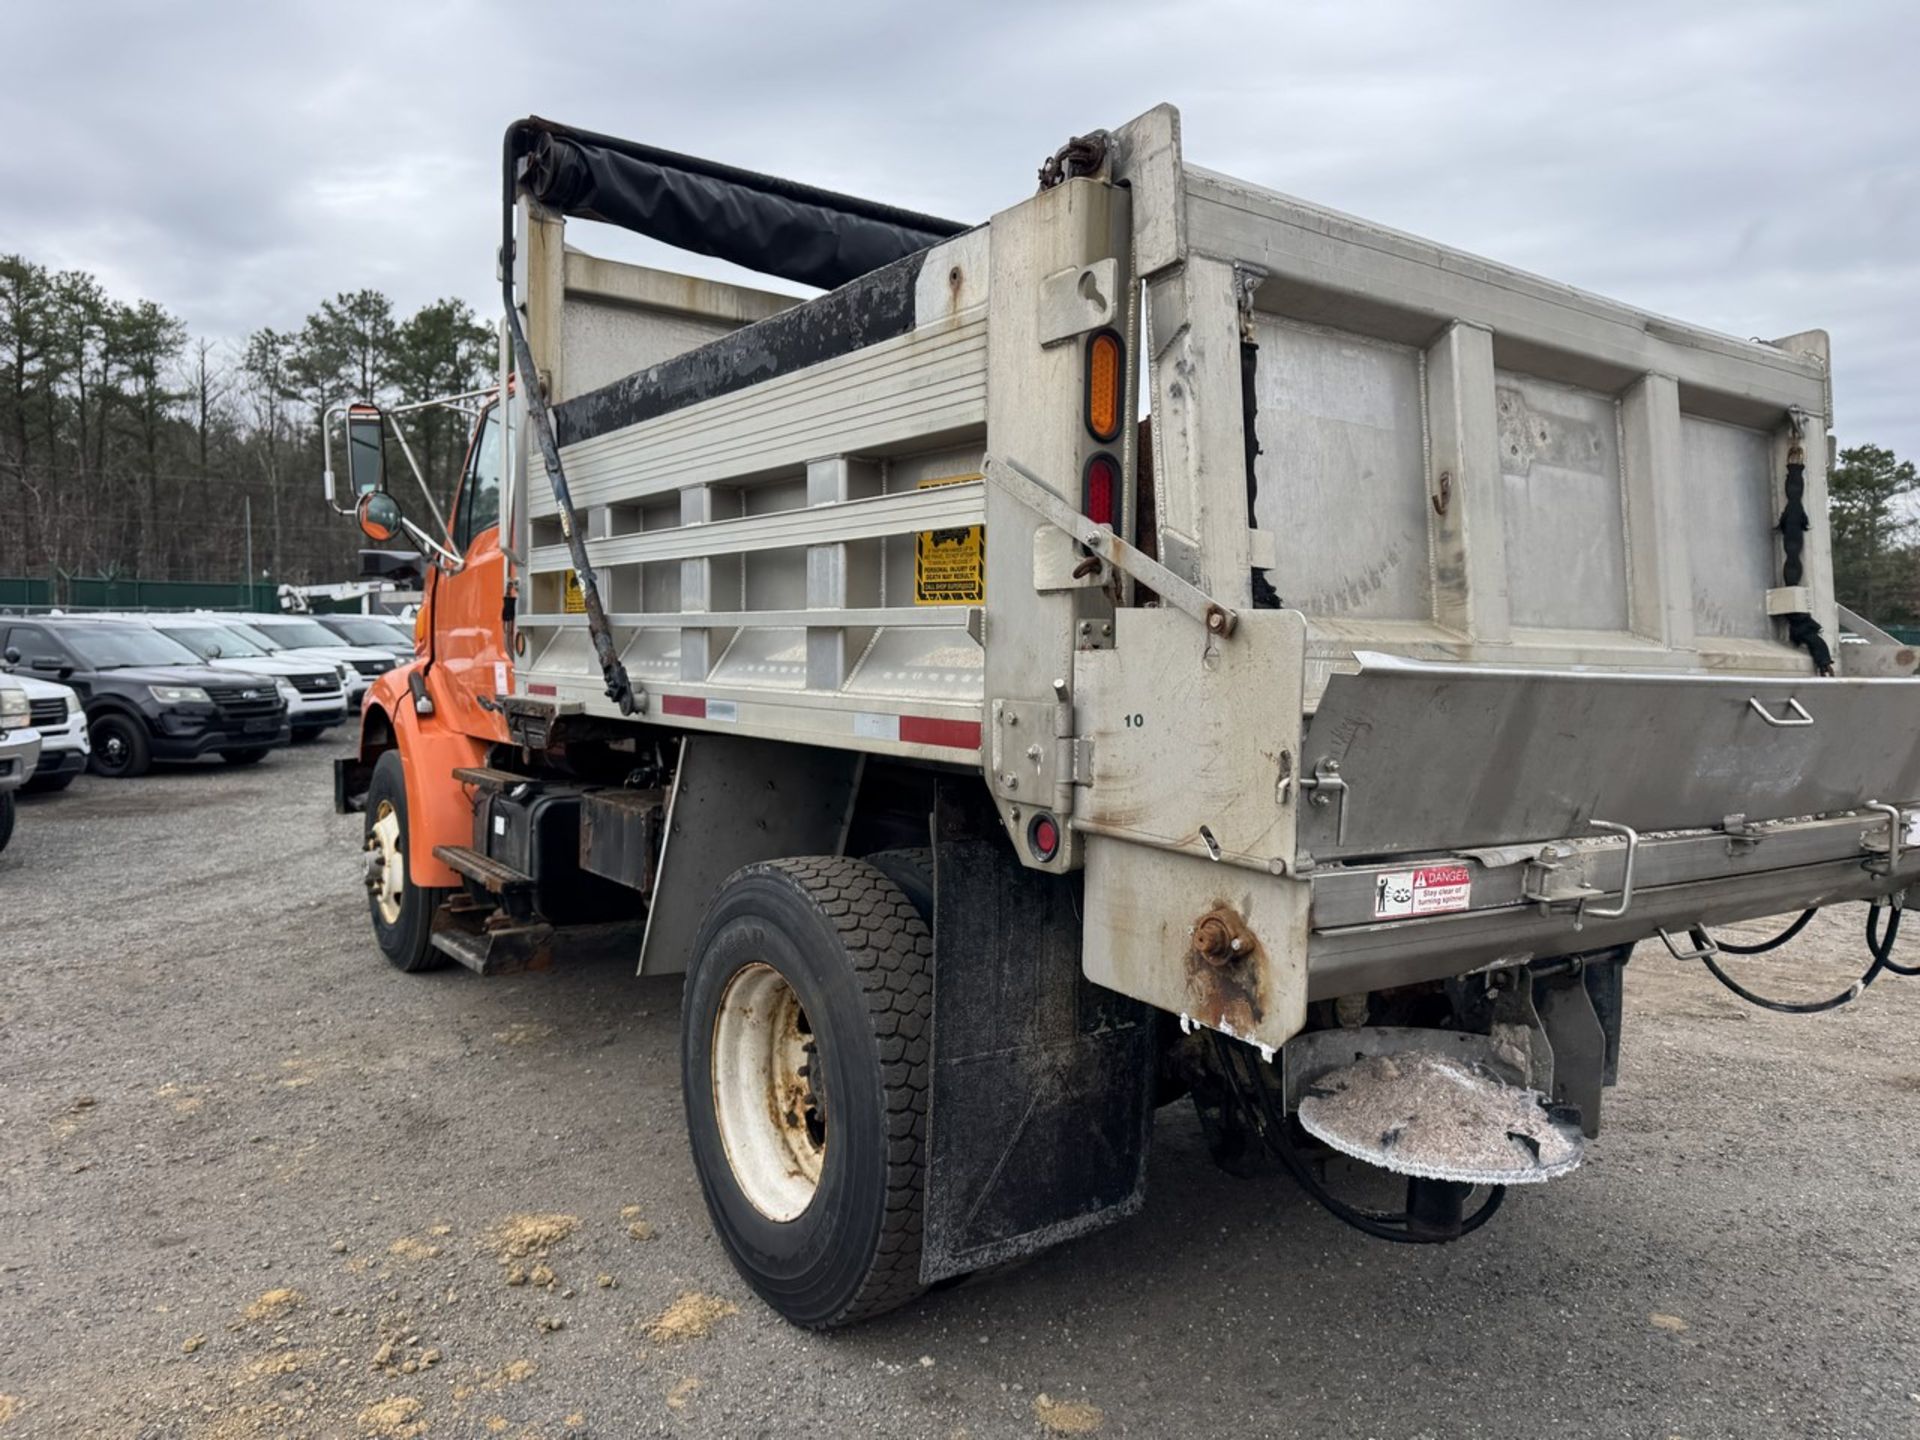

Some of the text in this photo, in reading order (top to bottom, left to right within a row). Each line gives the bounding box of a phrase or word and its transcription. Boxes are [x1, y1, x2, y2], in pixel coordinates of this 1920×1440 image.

[1124, 714, 1143, 727] 10
[1428, 869, 1470, 883] DANGER
[1423, 889, 1437, 897] Stay
[1438, 887, 1454, 895] clear
[1418, 895, 1465, 905] turning spinner
